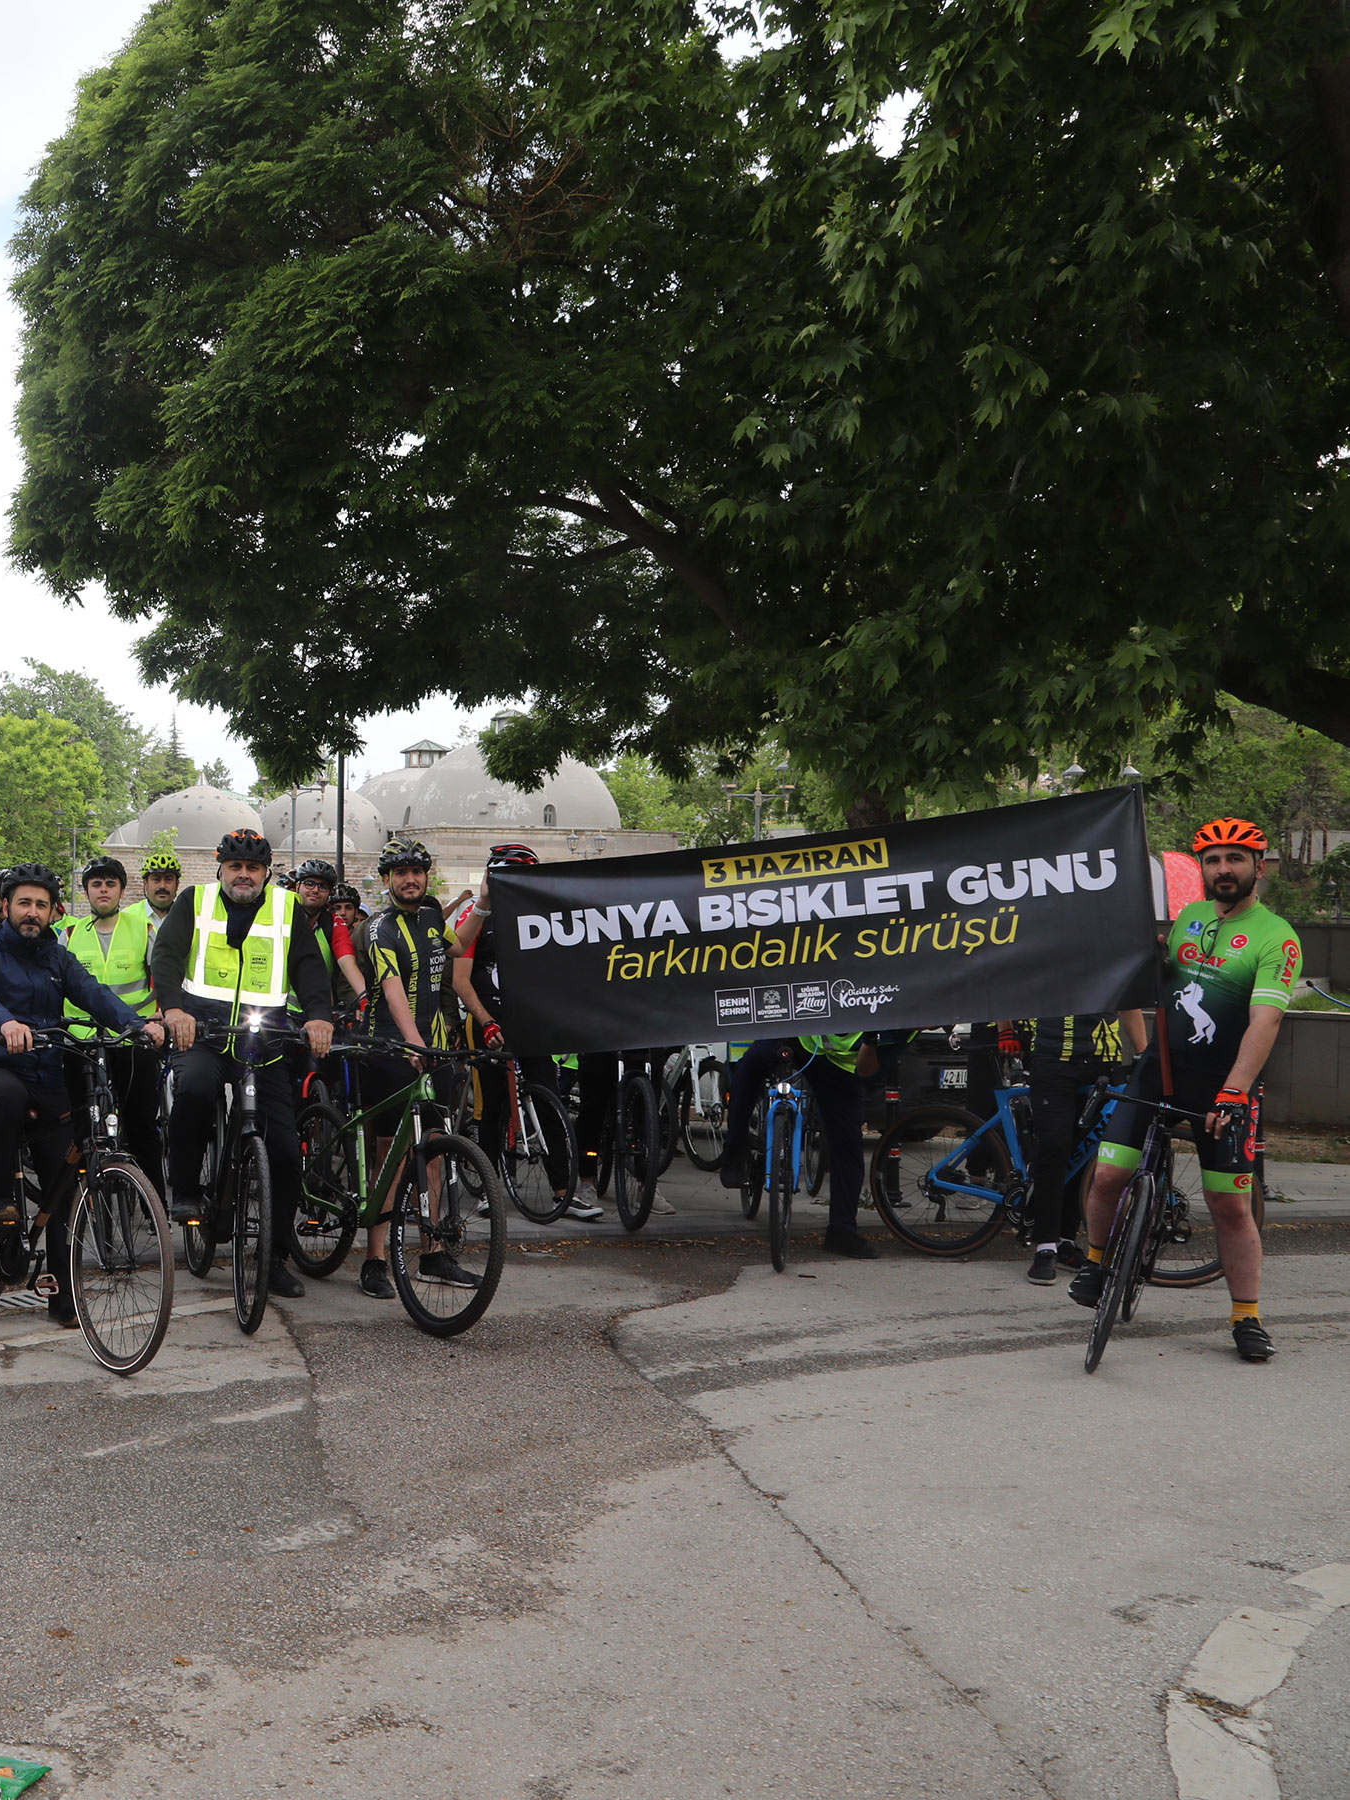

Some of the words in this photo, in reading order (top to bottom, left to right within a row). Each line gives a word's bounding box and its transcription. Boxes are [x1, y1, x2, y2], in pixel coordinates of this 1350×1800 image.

[709, 861, 727, 883] 3
[735, 842, 883, 880] HAZİRAN
[517, 899, 690, 950] DÜNYA
[698, 870, 934, 932] BİSİKLET
[947, 848, 1117, 905] GÜNÜ
[606, 923, 842, 981] farkındalık
[854, 906, 1019, 958] sürüşü
[719, 997, 749, 1008] BENİM
[719, 1007, 750, 1017] ŞEHRİM
[839, 991, 893, 1014] Konya
